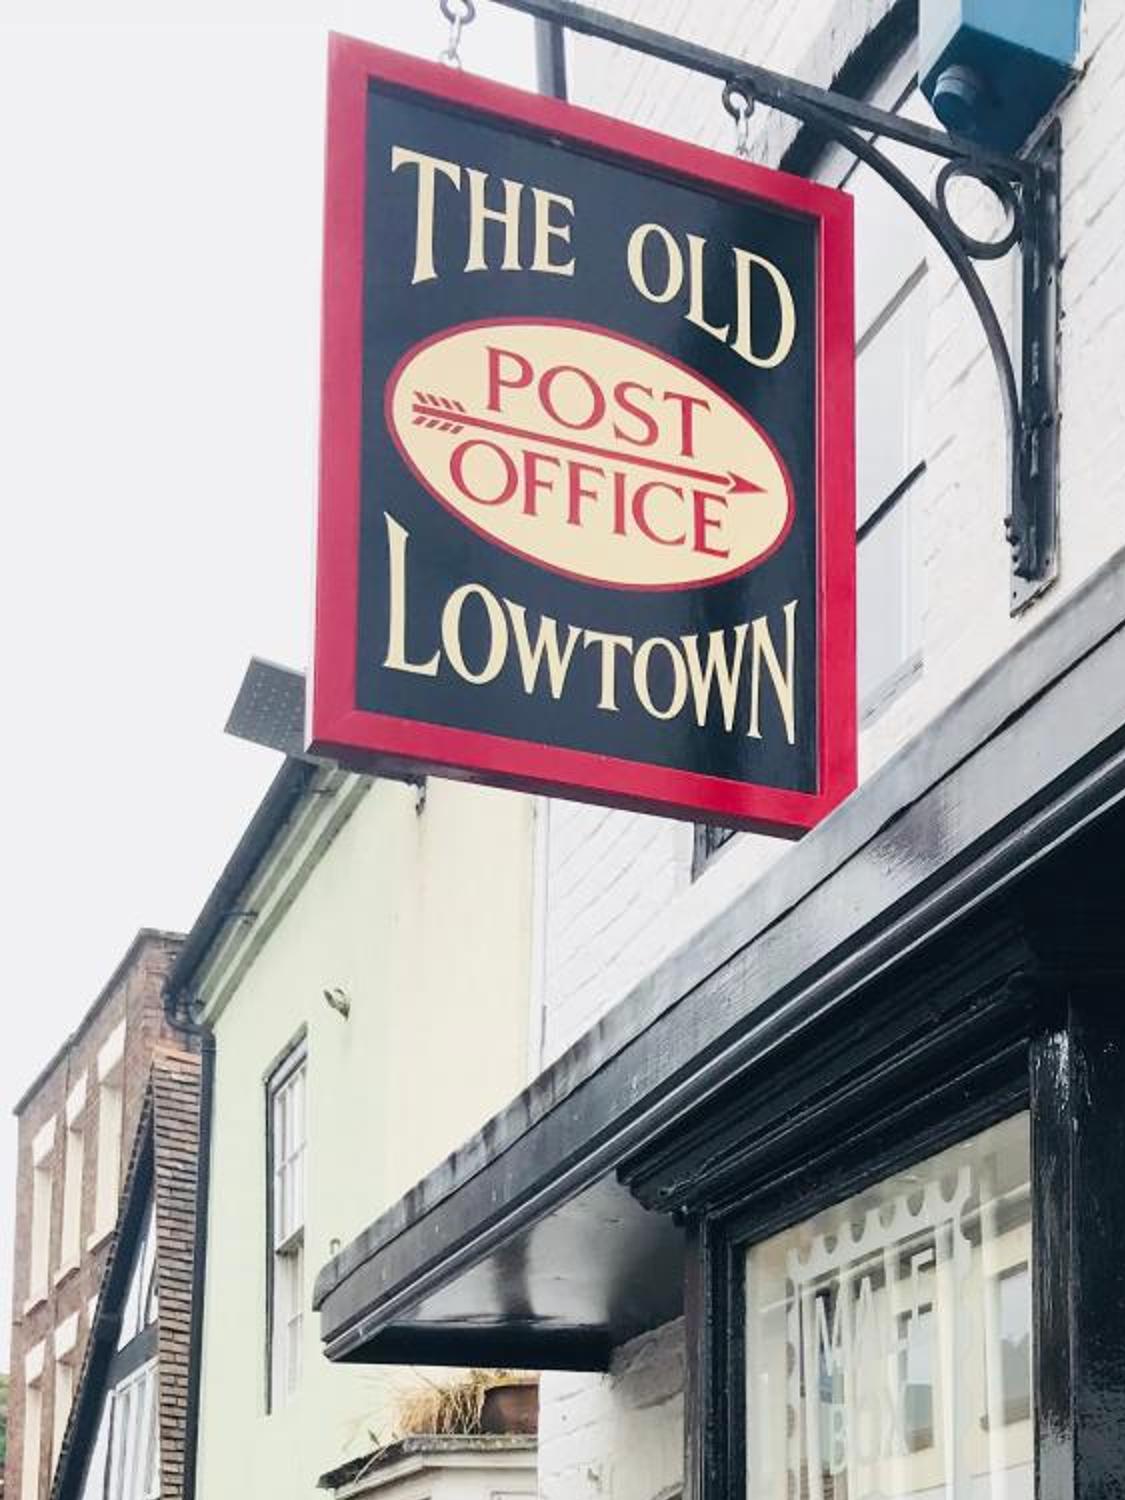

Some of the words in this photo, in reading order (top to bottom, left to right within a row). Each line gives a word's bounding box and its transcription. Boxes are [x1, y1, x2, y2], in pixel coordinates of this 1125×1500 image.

[391, 146, 576, 285] THE
[627, 223, 798, 370] OLD
[485, 346, 711, 459] POST
[449, 439, 731, 560] OFFICE
[383, 512, 799, 746] LOWTOWN
